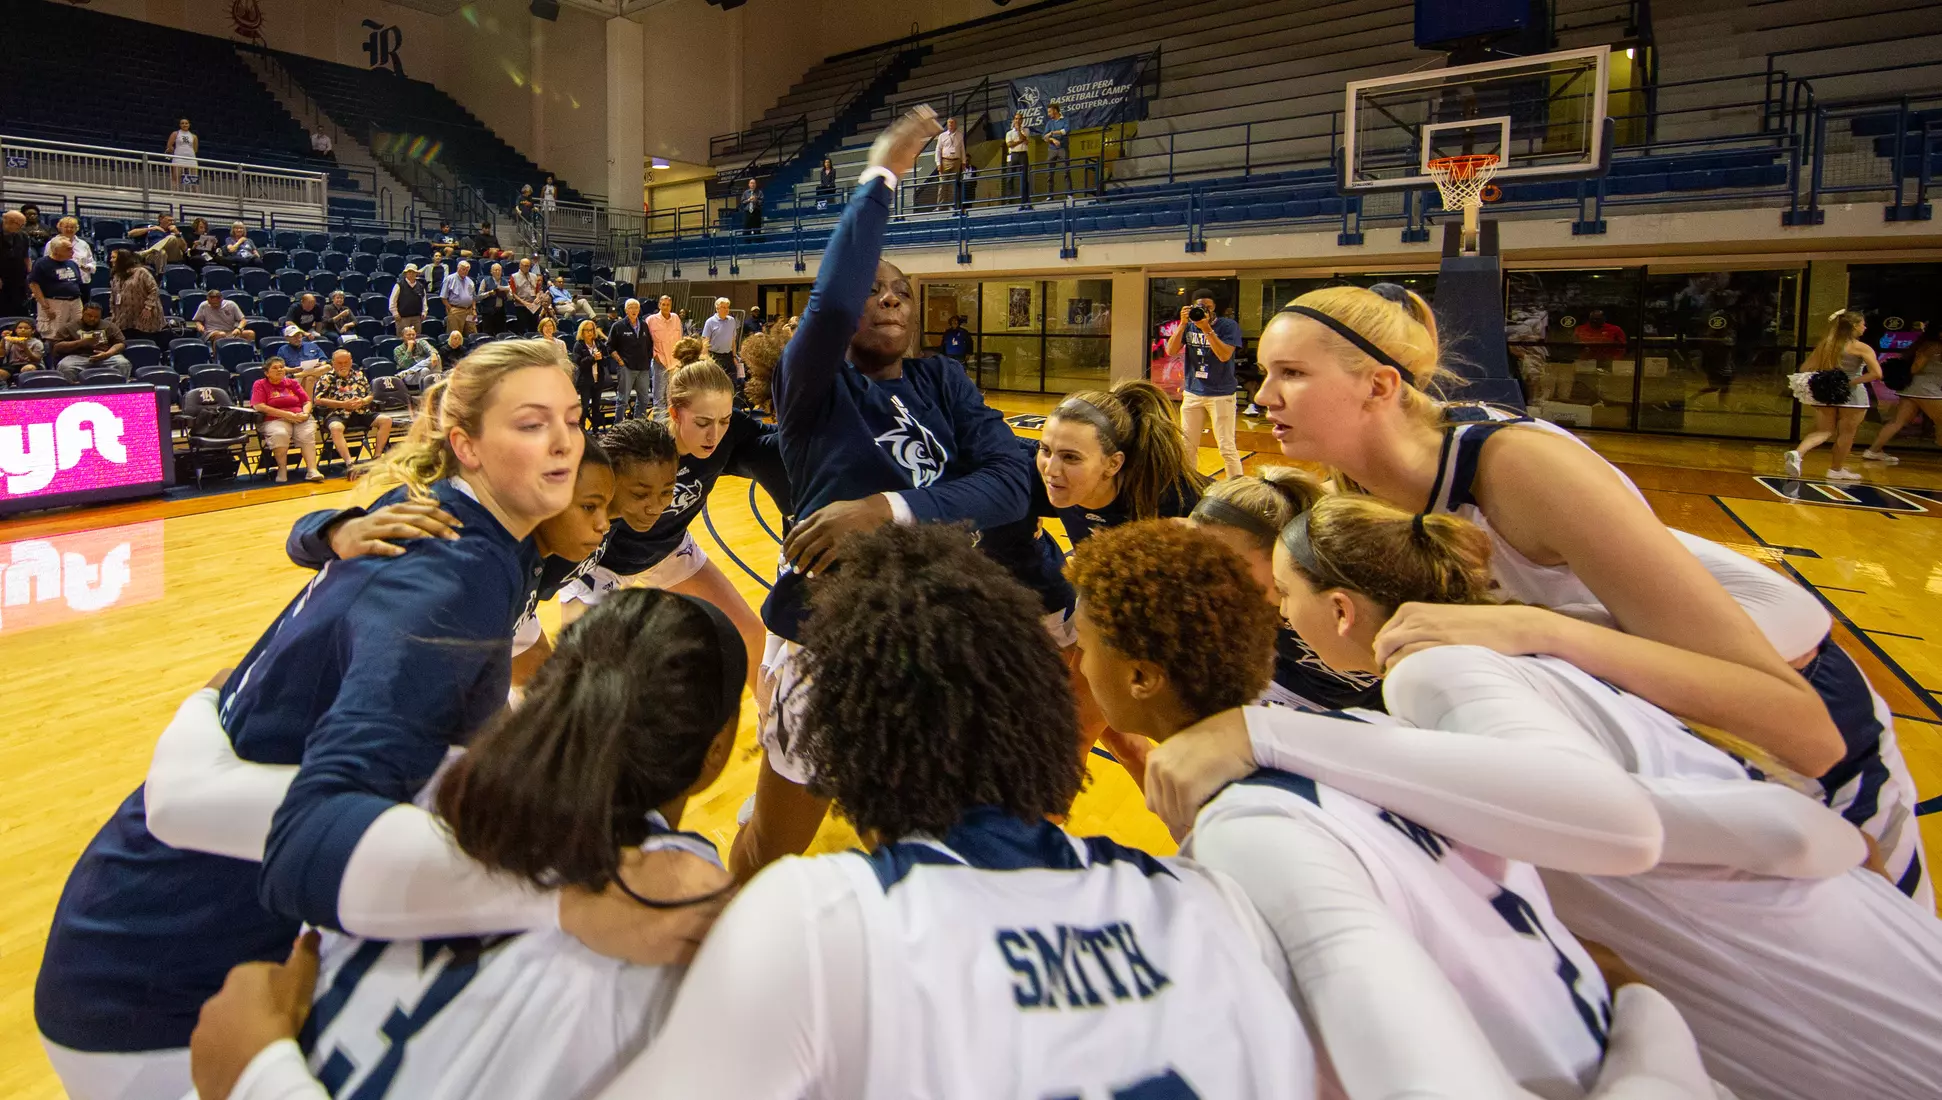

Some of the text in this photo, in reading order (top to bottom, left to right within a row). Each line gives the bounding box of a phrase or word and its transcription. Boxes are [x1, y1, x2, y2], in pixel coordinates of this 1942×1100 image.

[1050, 84, 1132, 105] BASKETBALL CAMPS
[1067, 79, 1114, 94] SCOTT PERA
[0, 401, 128, 495] yft
[995, 919, 1172, 1013] SMITH
